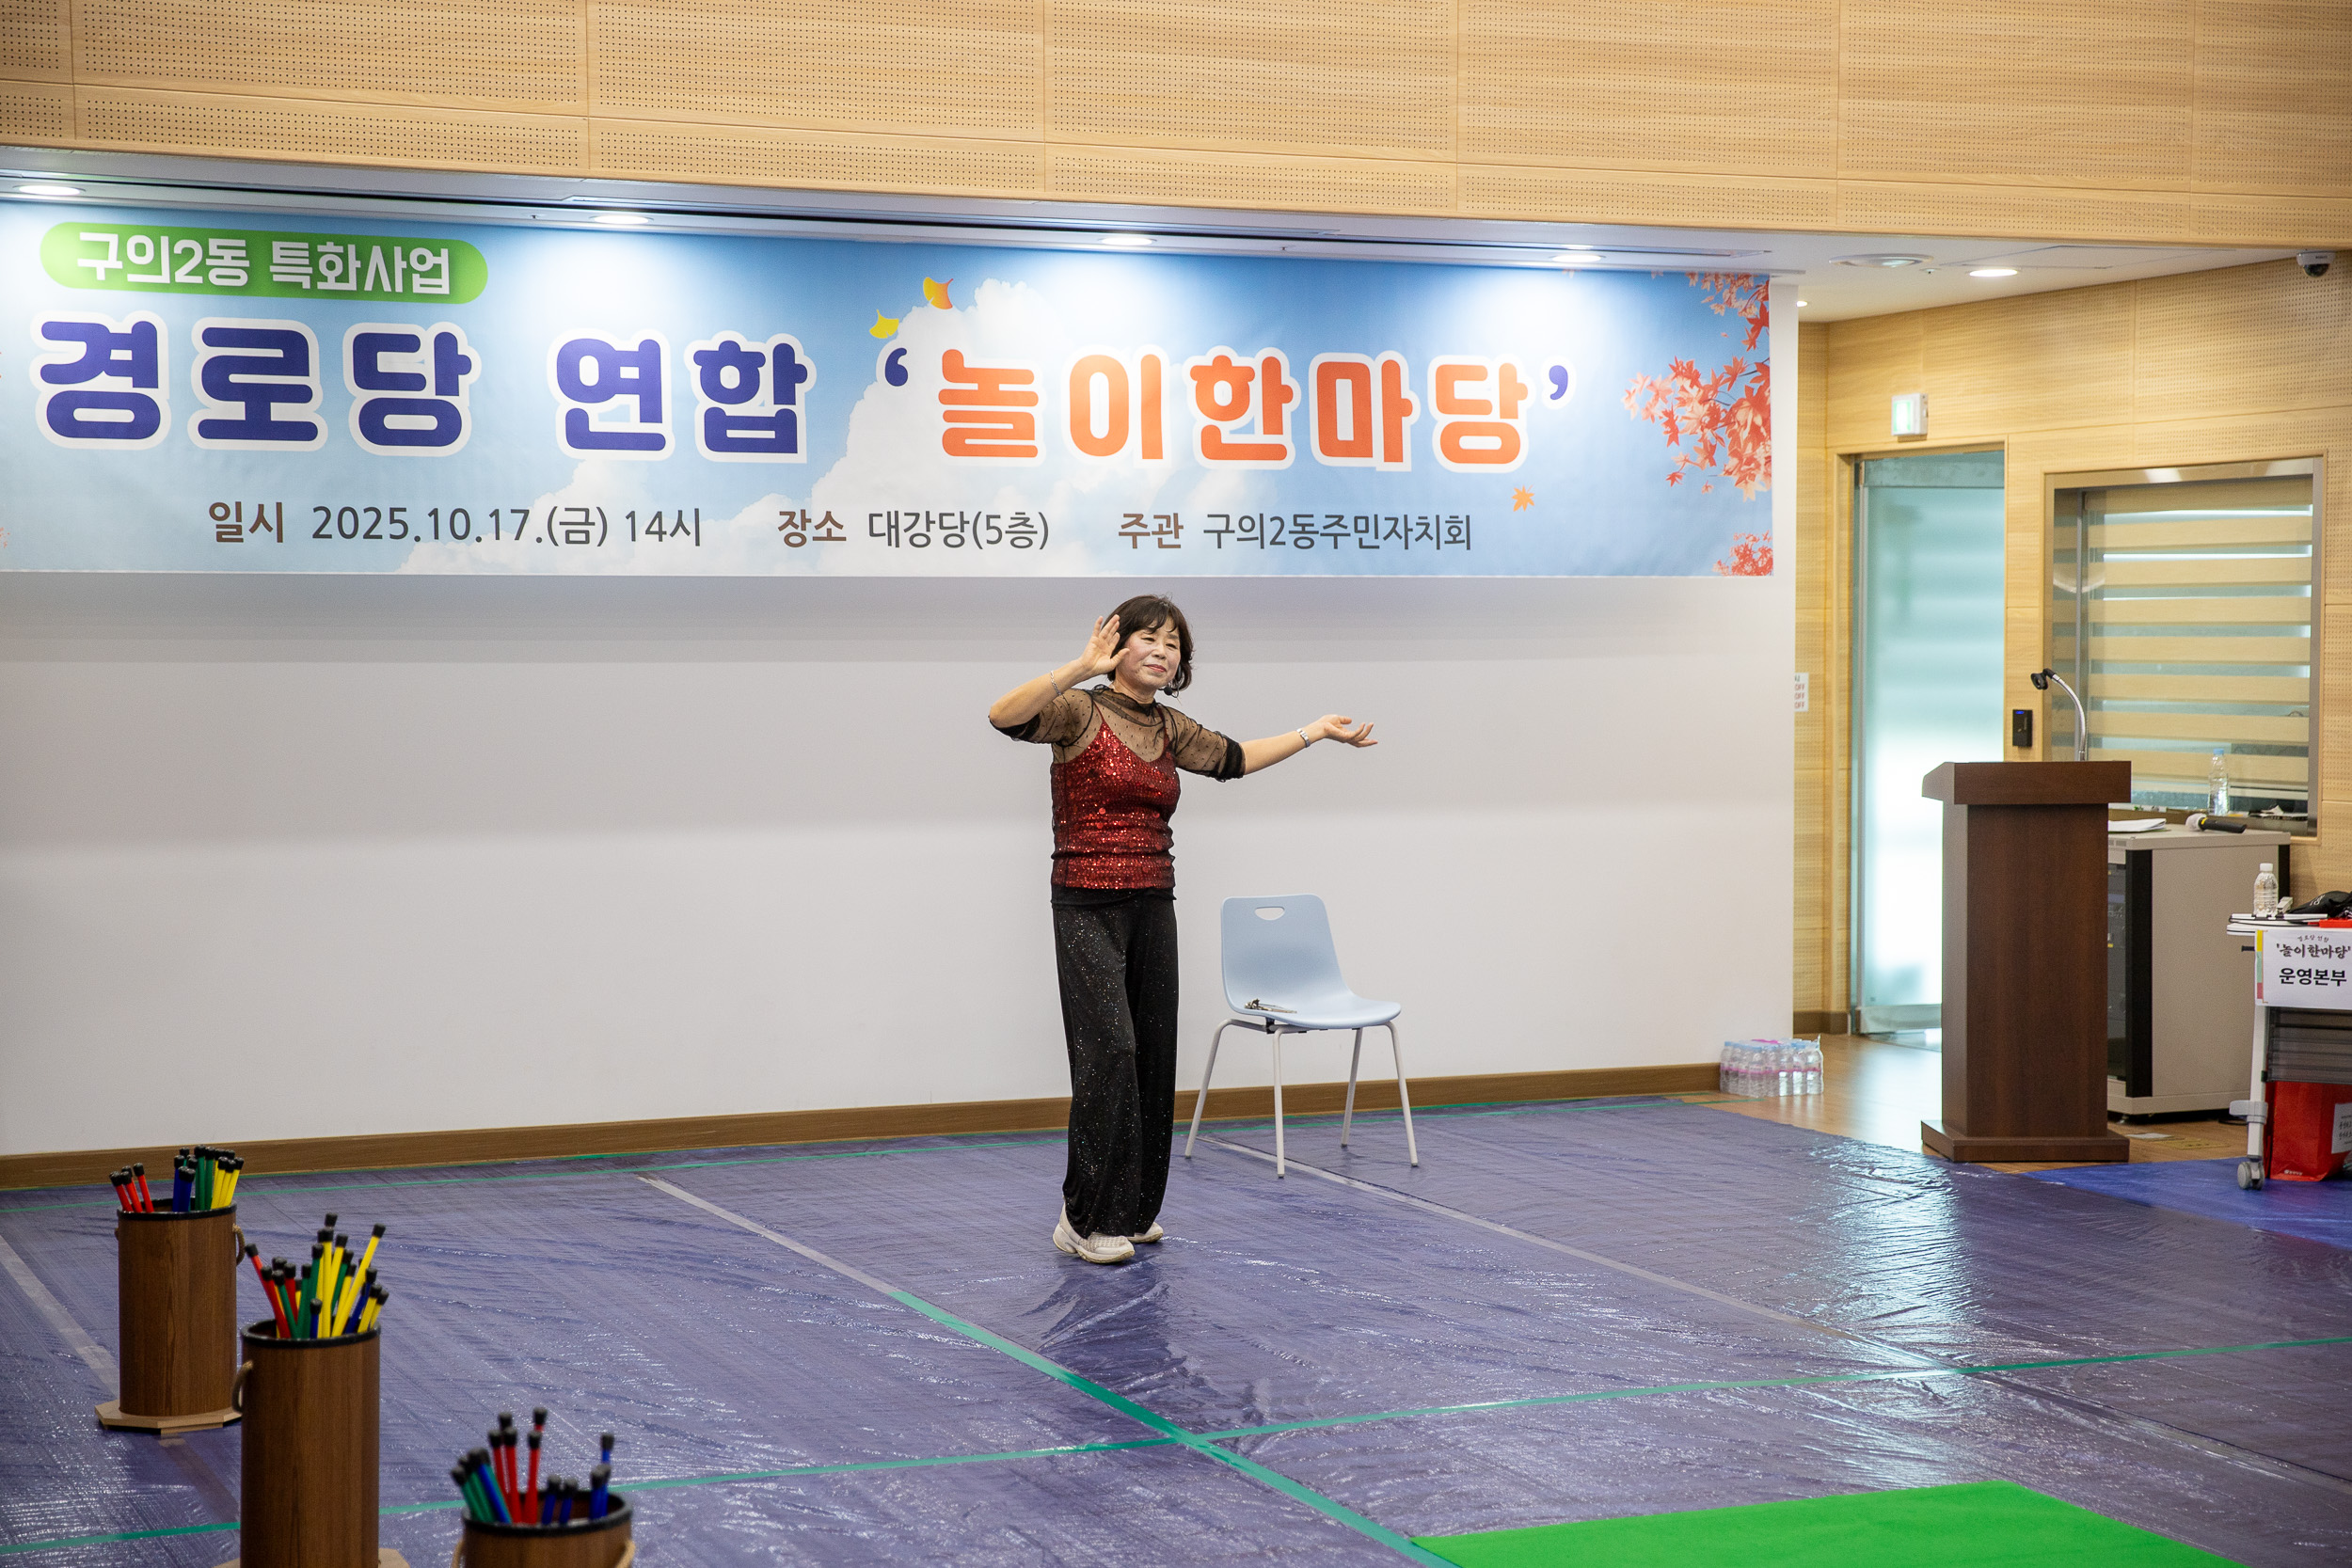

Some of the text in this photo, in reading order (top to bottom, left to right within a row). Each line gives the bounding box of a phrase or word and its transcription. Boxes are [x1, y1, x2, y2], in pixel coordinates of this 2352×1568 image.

[77, 231, 451, 295] 구의2동 특화사업
[40, 320, 1569, 465] 경로당 연합 ‘놀이한마당’
[208, 501, 1472, 551] 일시 2025.10.17.(금) 14시 장소 대강당(5층) 주관 구의2동주민자치회
[2279, 968, 2347, 987] 운영본부
